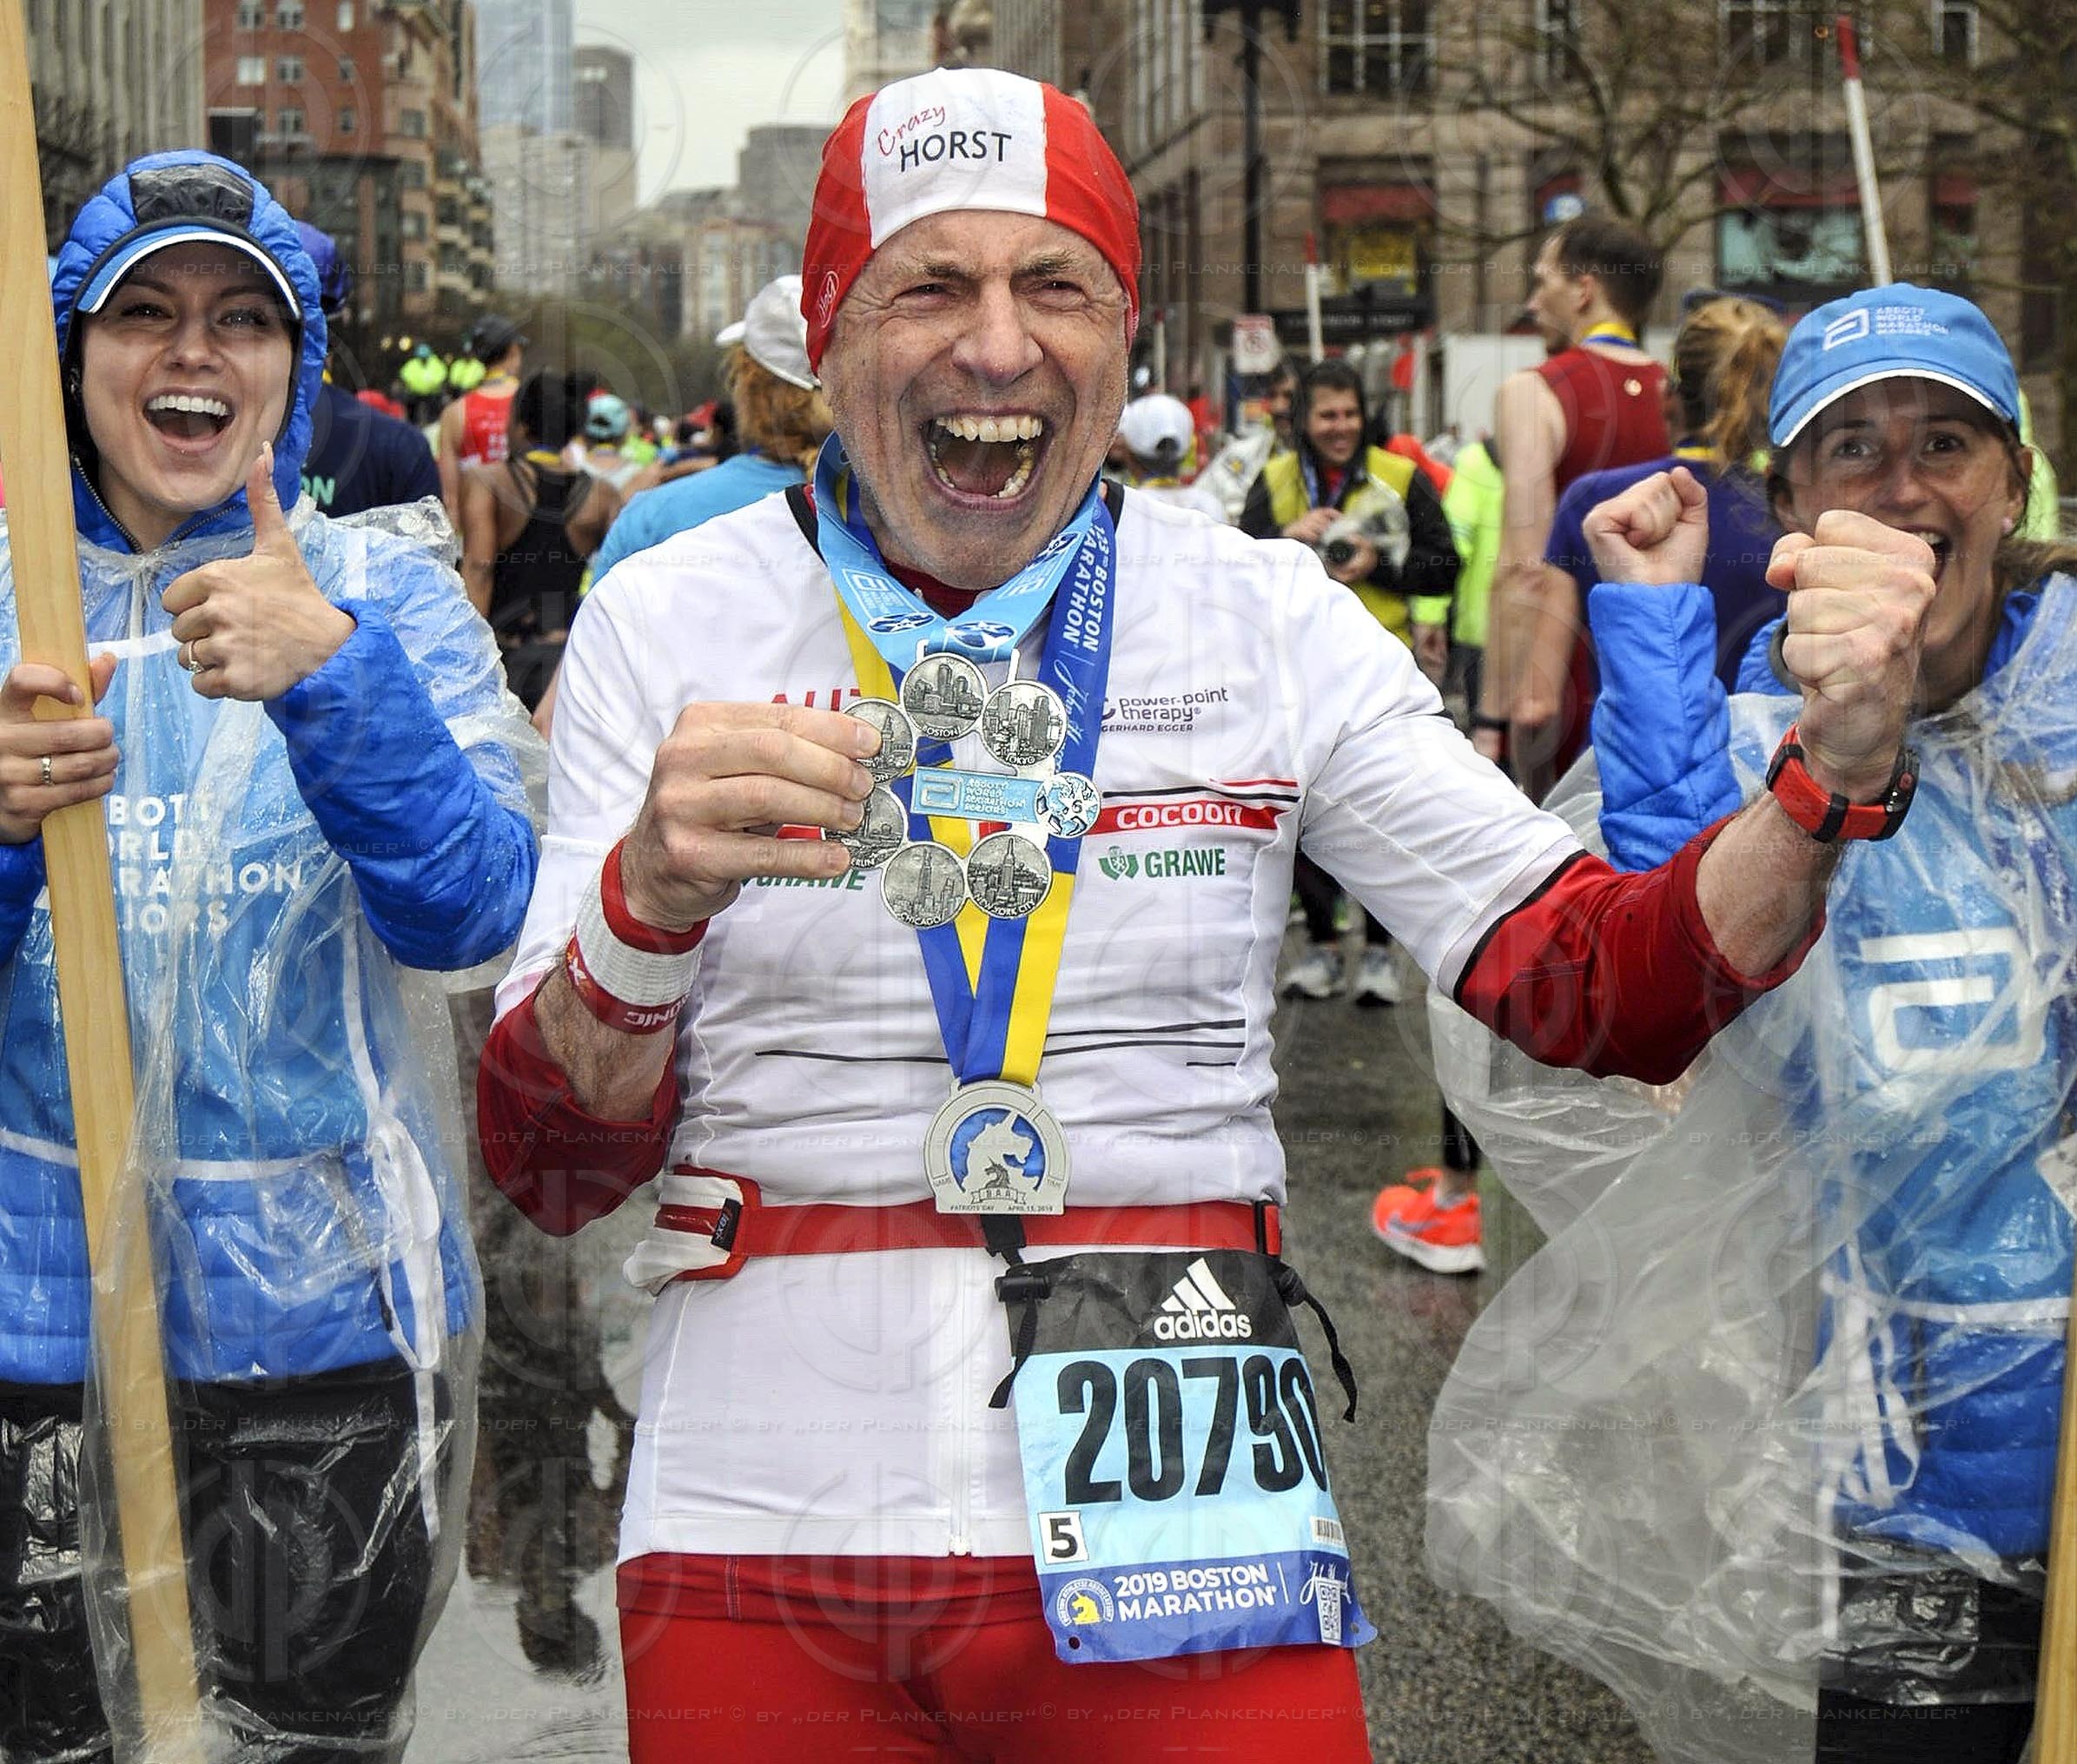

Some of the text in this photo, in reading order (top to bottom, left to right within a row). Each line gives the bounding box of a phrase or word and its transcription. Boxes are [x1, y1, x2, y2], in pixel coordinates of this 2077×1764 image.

[877, 106, 946, 156] Crazy
[900, 130, 1012, 173] HORST
[1082, 565, 1108, 653] BOSTON
[1119, 687, 1229, 706] power-point
[1101, 723, 1194, 733] GERHARD EGGER
[1005, 754, 1035, 765] TOKYO
[109, 792, 210, 826] BOTT
[114, 860, 302, 896] RATHON
[1144, 848, 1226, 878] GRAWE
[897, 913, 943, 926] CHICAGO
[1154, 1308, 1253, 1340] adidas
[1056, 1353, 1328, 1506] 20790
[1048, 1516, 1079, 1560] 5
[1114, 1564, 1268, 1598] 2019 BOSTON
